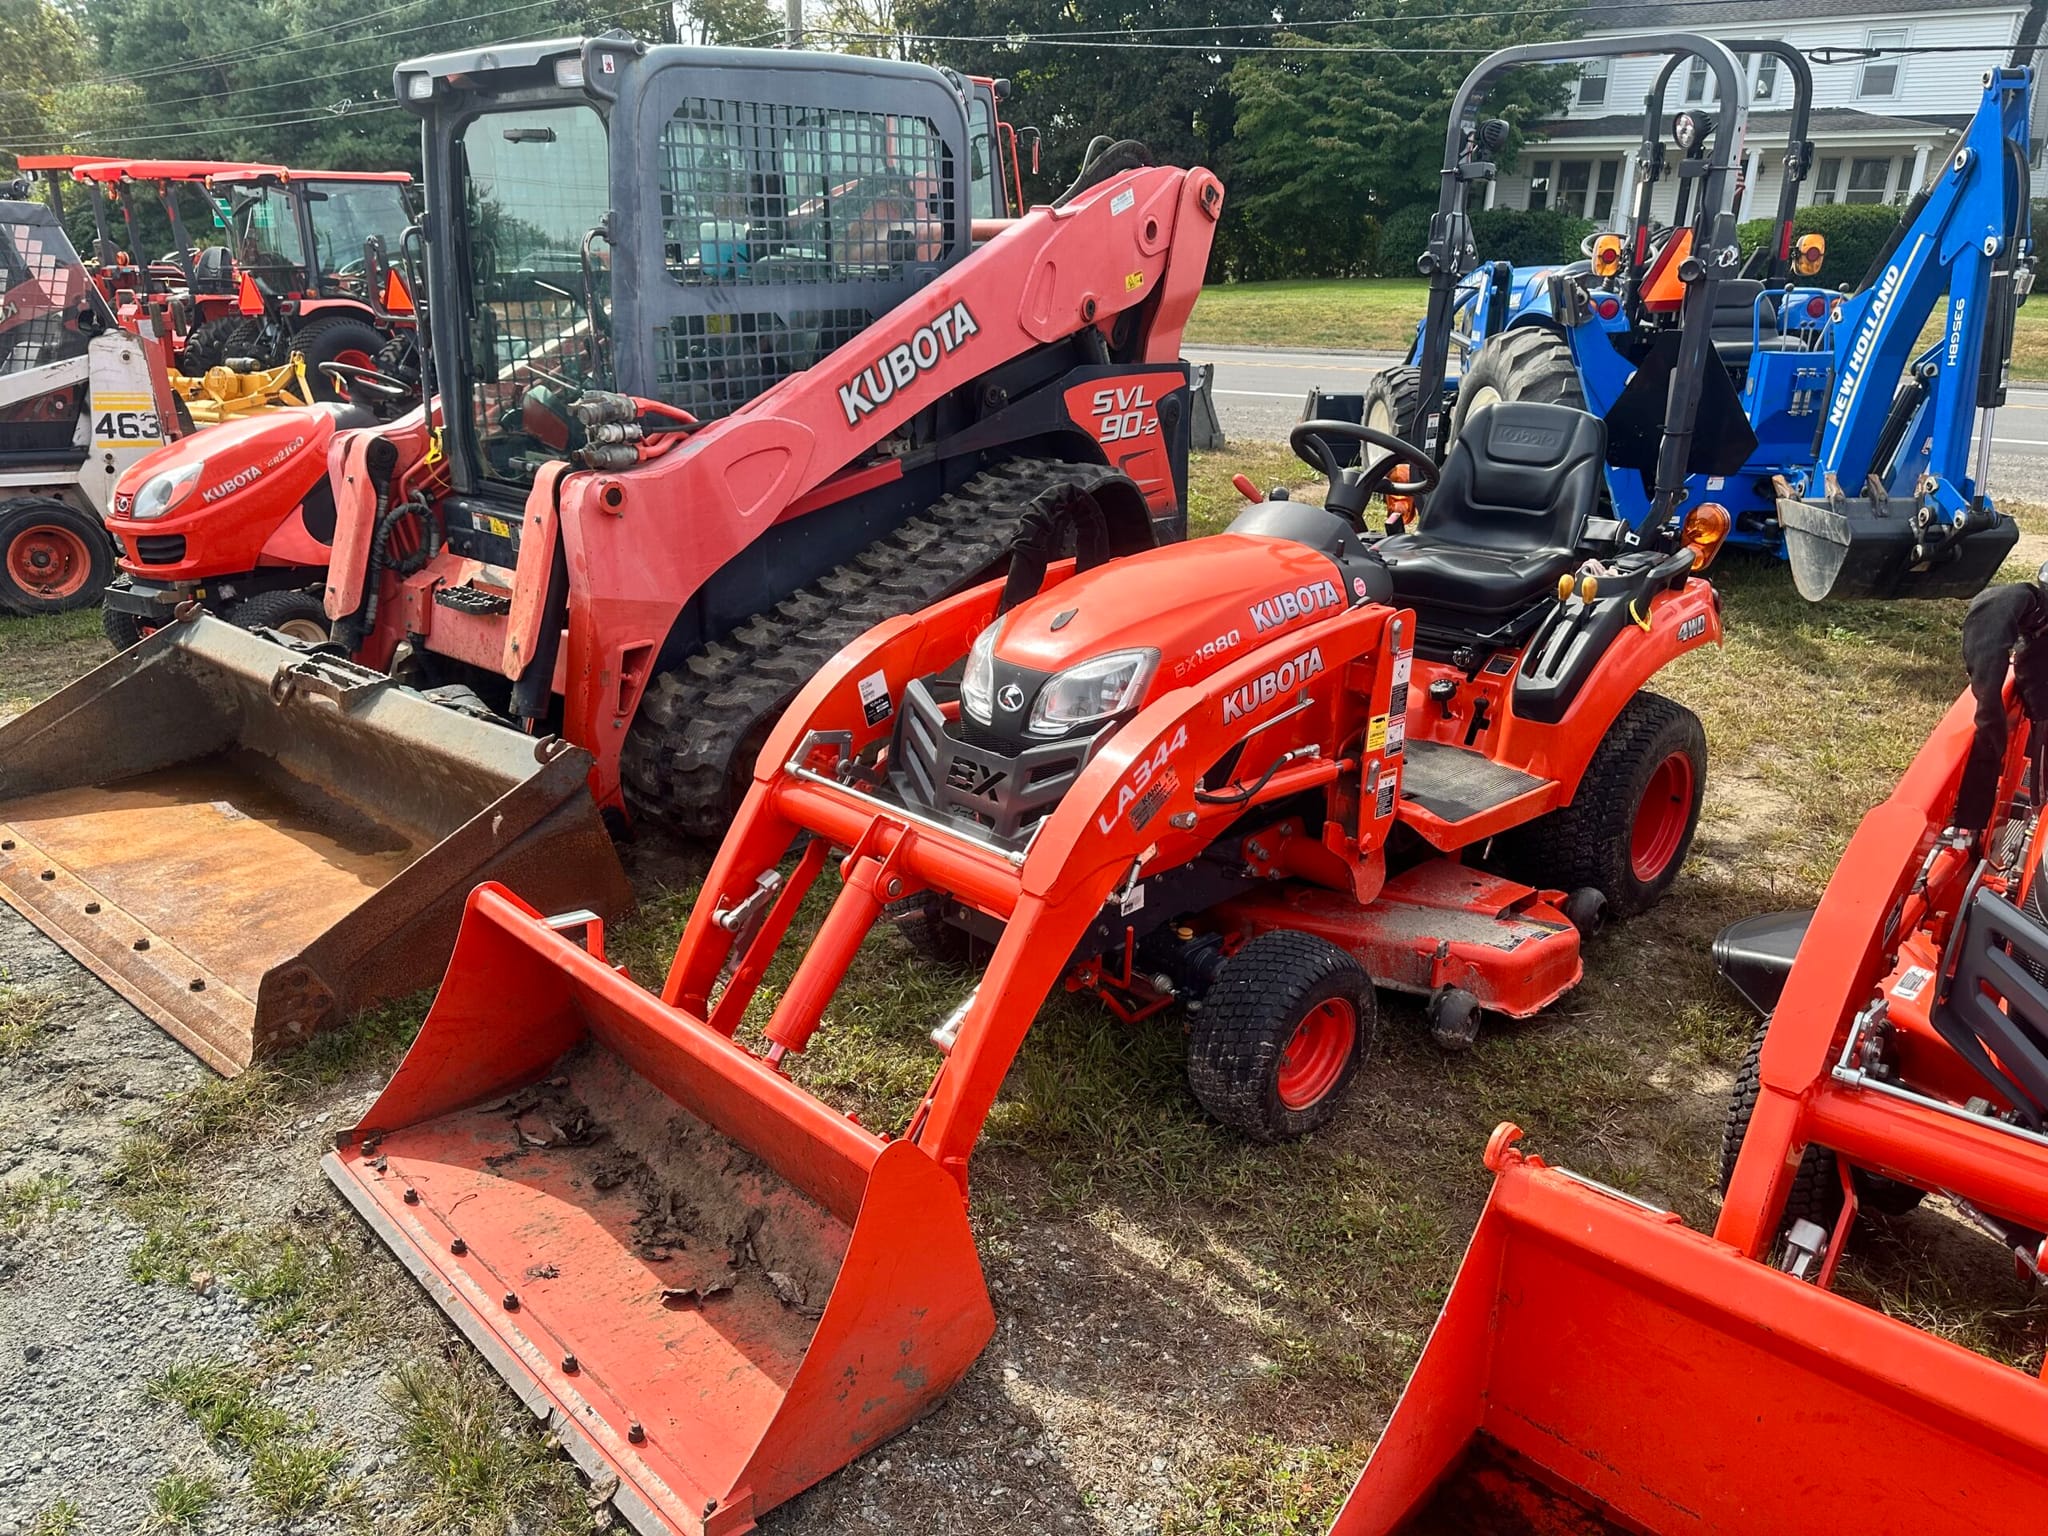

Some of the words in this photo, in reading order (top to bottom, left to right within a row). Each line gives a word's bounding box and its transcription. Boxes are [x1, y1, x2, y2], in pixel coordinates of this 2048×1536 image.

[838, 300, 980, 426] KUBOTA
[1829, 371, 1856, 427] NEW
[1848, 264, 1900, 374] HOLLAND
[1091, 384, 1154, 416] SVL
[95, 413, 161, 439] 463
[1099, 411, 1159, 444] 90-2
[201, 464, 263, 504] KUBOTA
[1248, 580, 1341, 634] KUBOTA
[1677, 613, 1706, 642] 4WD
[1173, 629, 1241, 679] BX1880
[1221, 646, 1325, 726] KUBOTA
[945, 755, 1008, 803] BX
[1098, 724, 1188, 835] LA344
